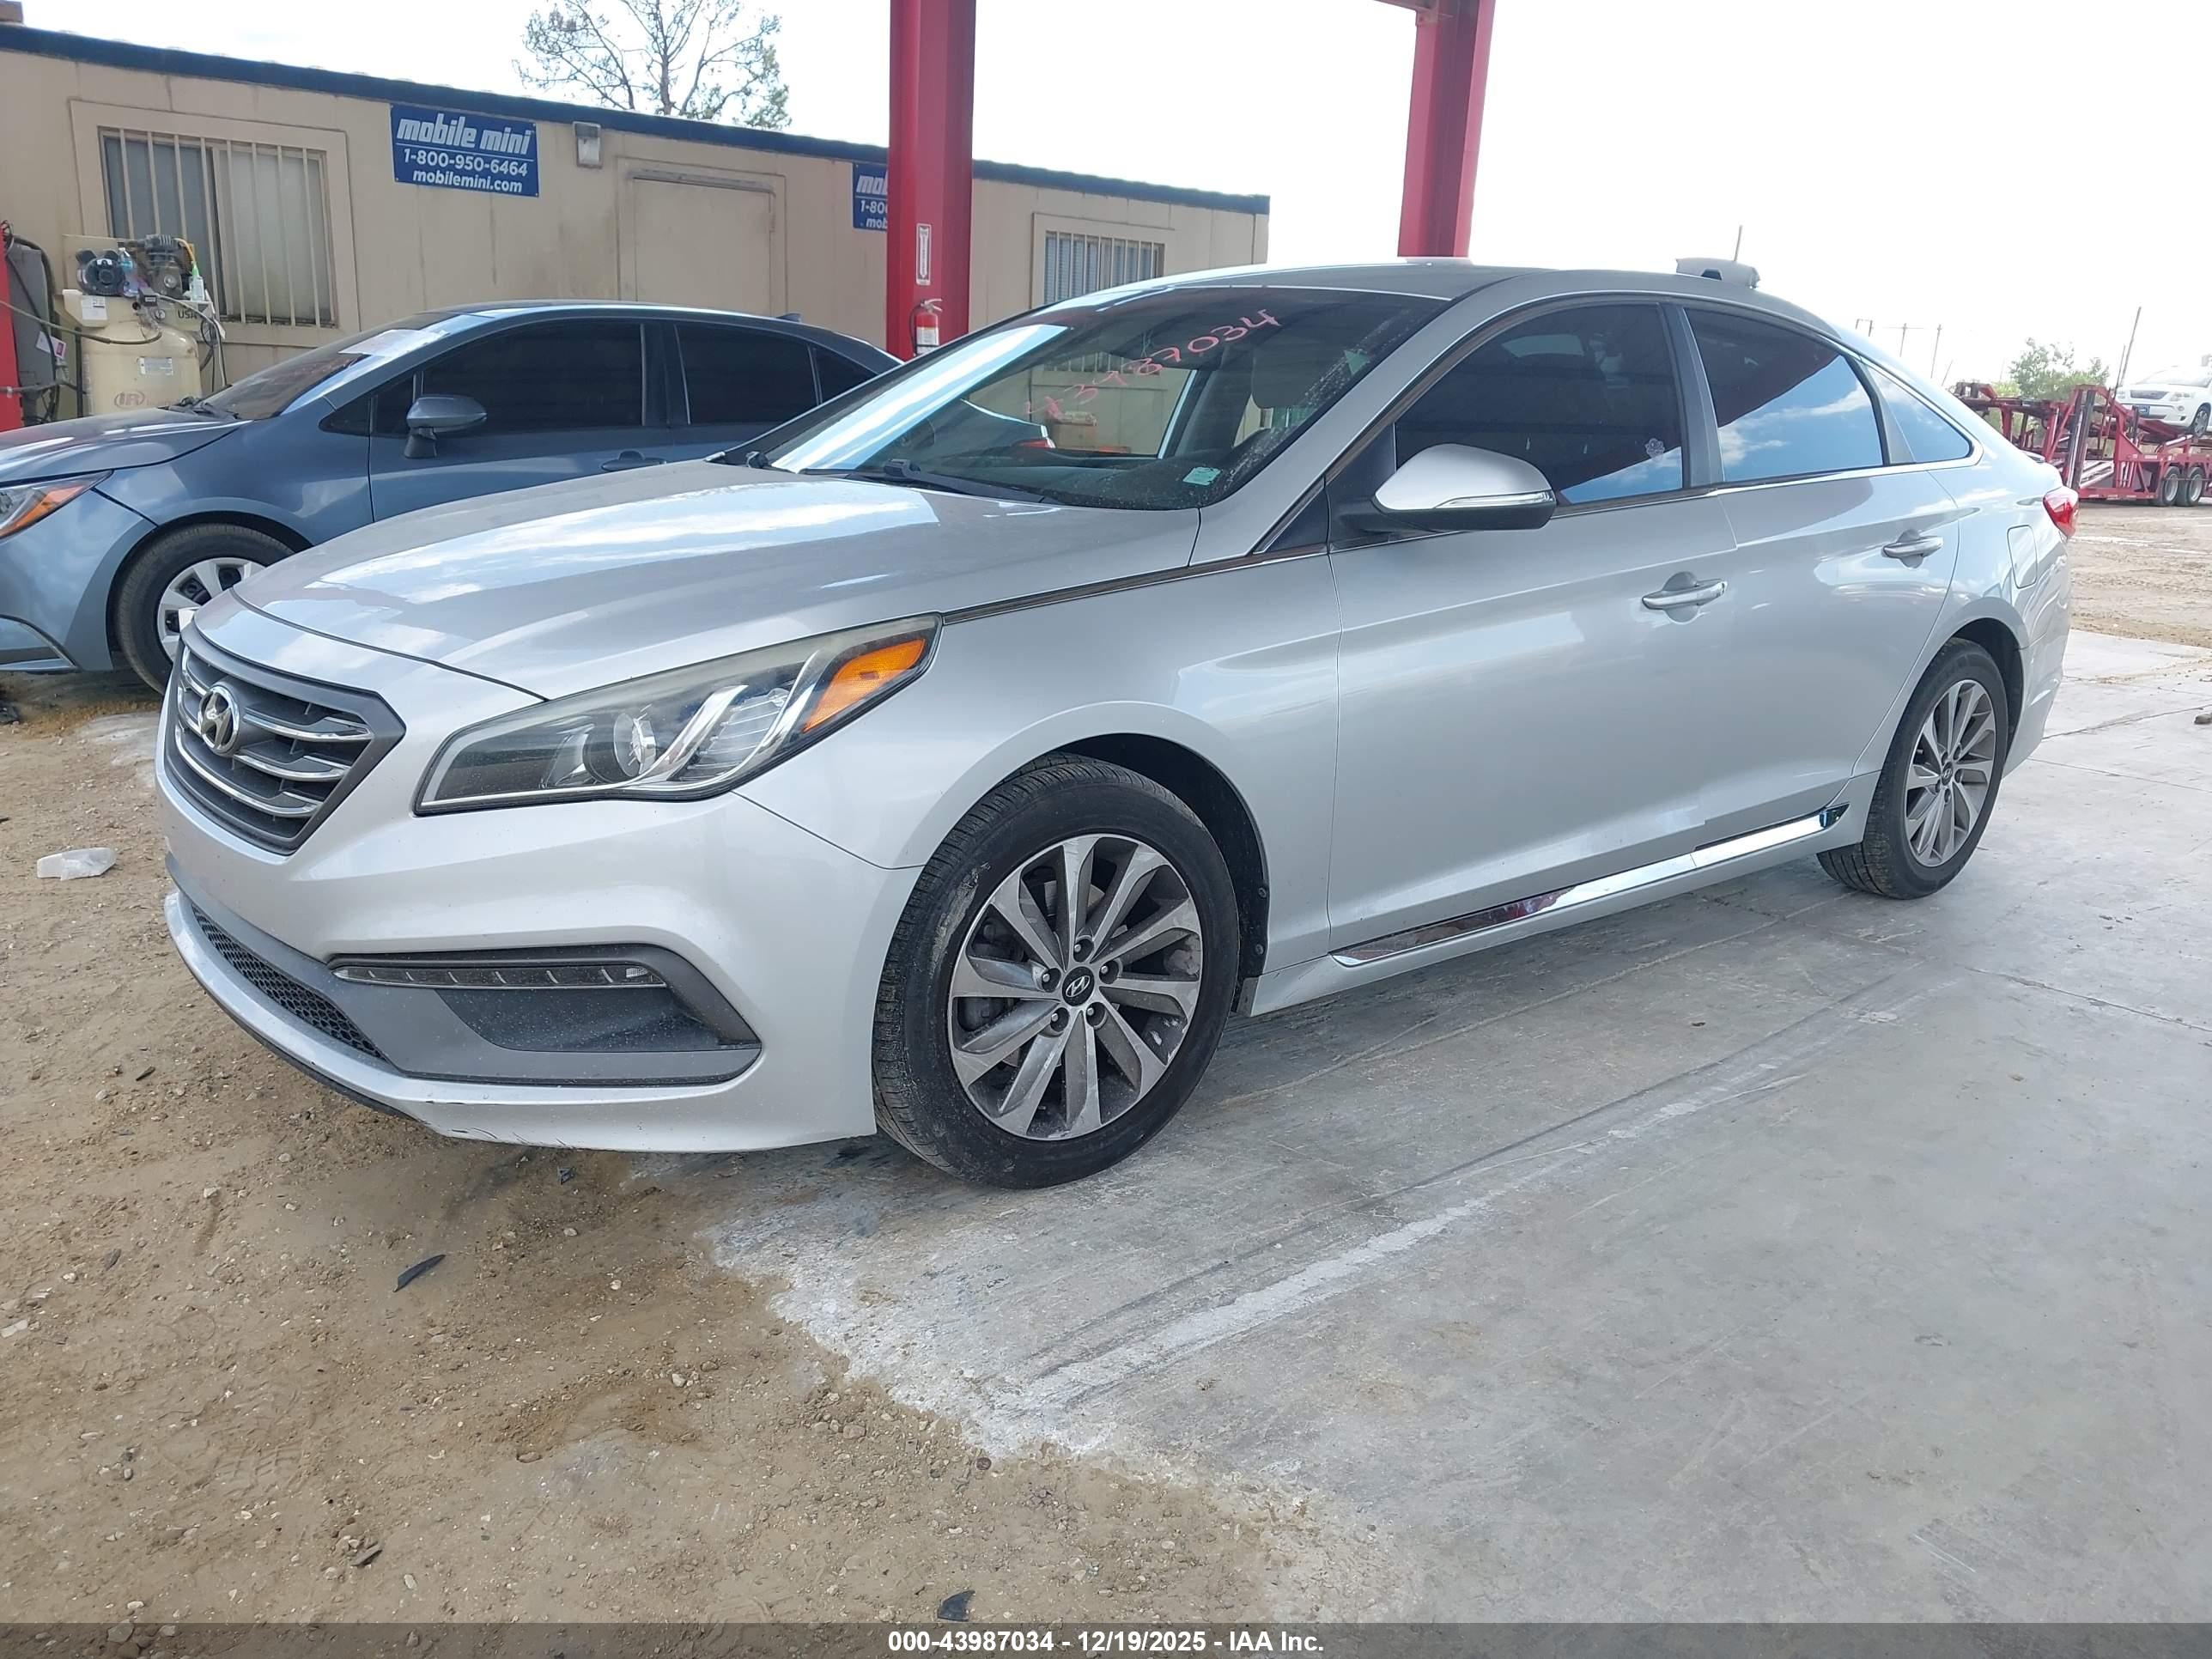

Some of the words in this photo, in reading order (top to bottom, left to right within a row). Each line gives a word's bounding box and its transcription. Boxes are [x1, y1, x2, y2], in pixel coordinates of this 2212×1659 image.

[397, 113, 477, 149] mobile
[479, 127, 532, 155] mini
[404, 148, 528, 177] 1-800-950-6464
[412, 170, 523, 193] mobilemini.com
[860, 200, 888, 215] 1-80
